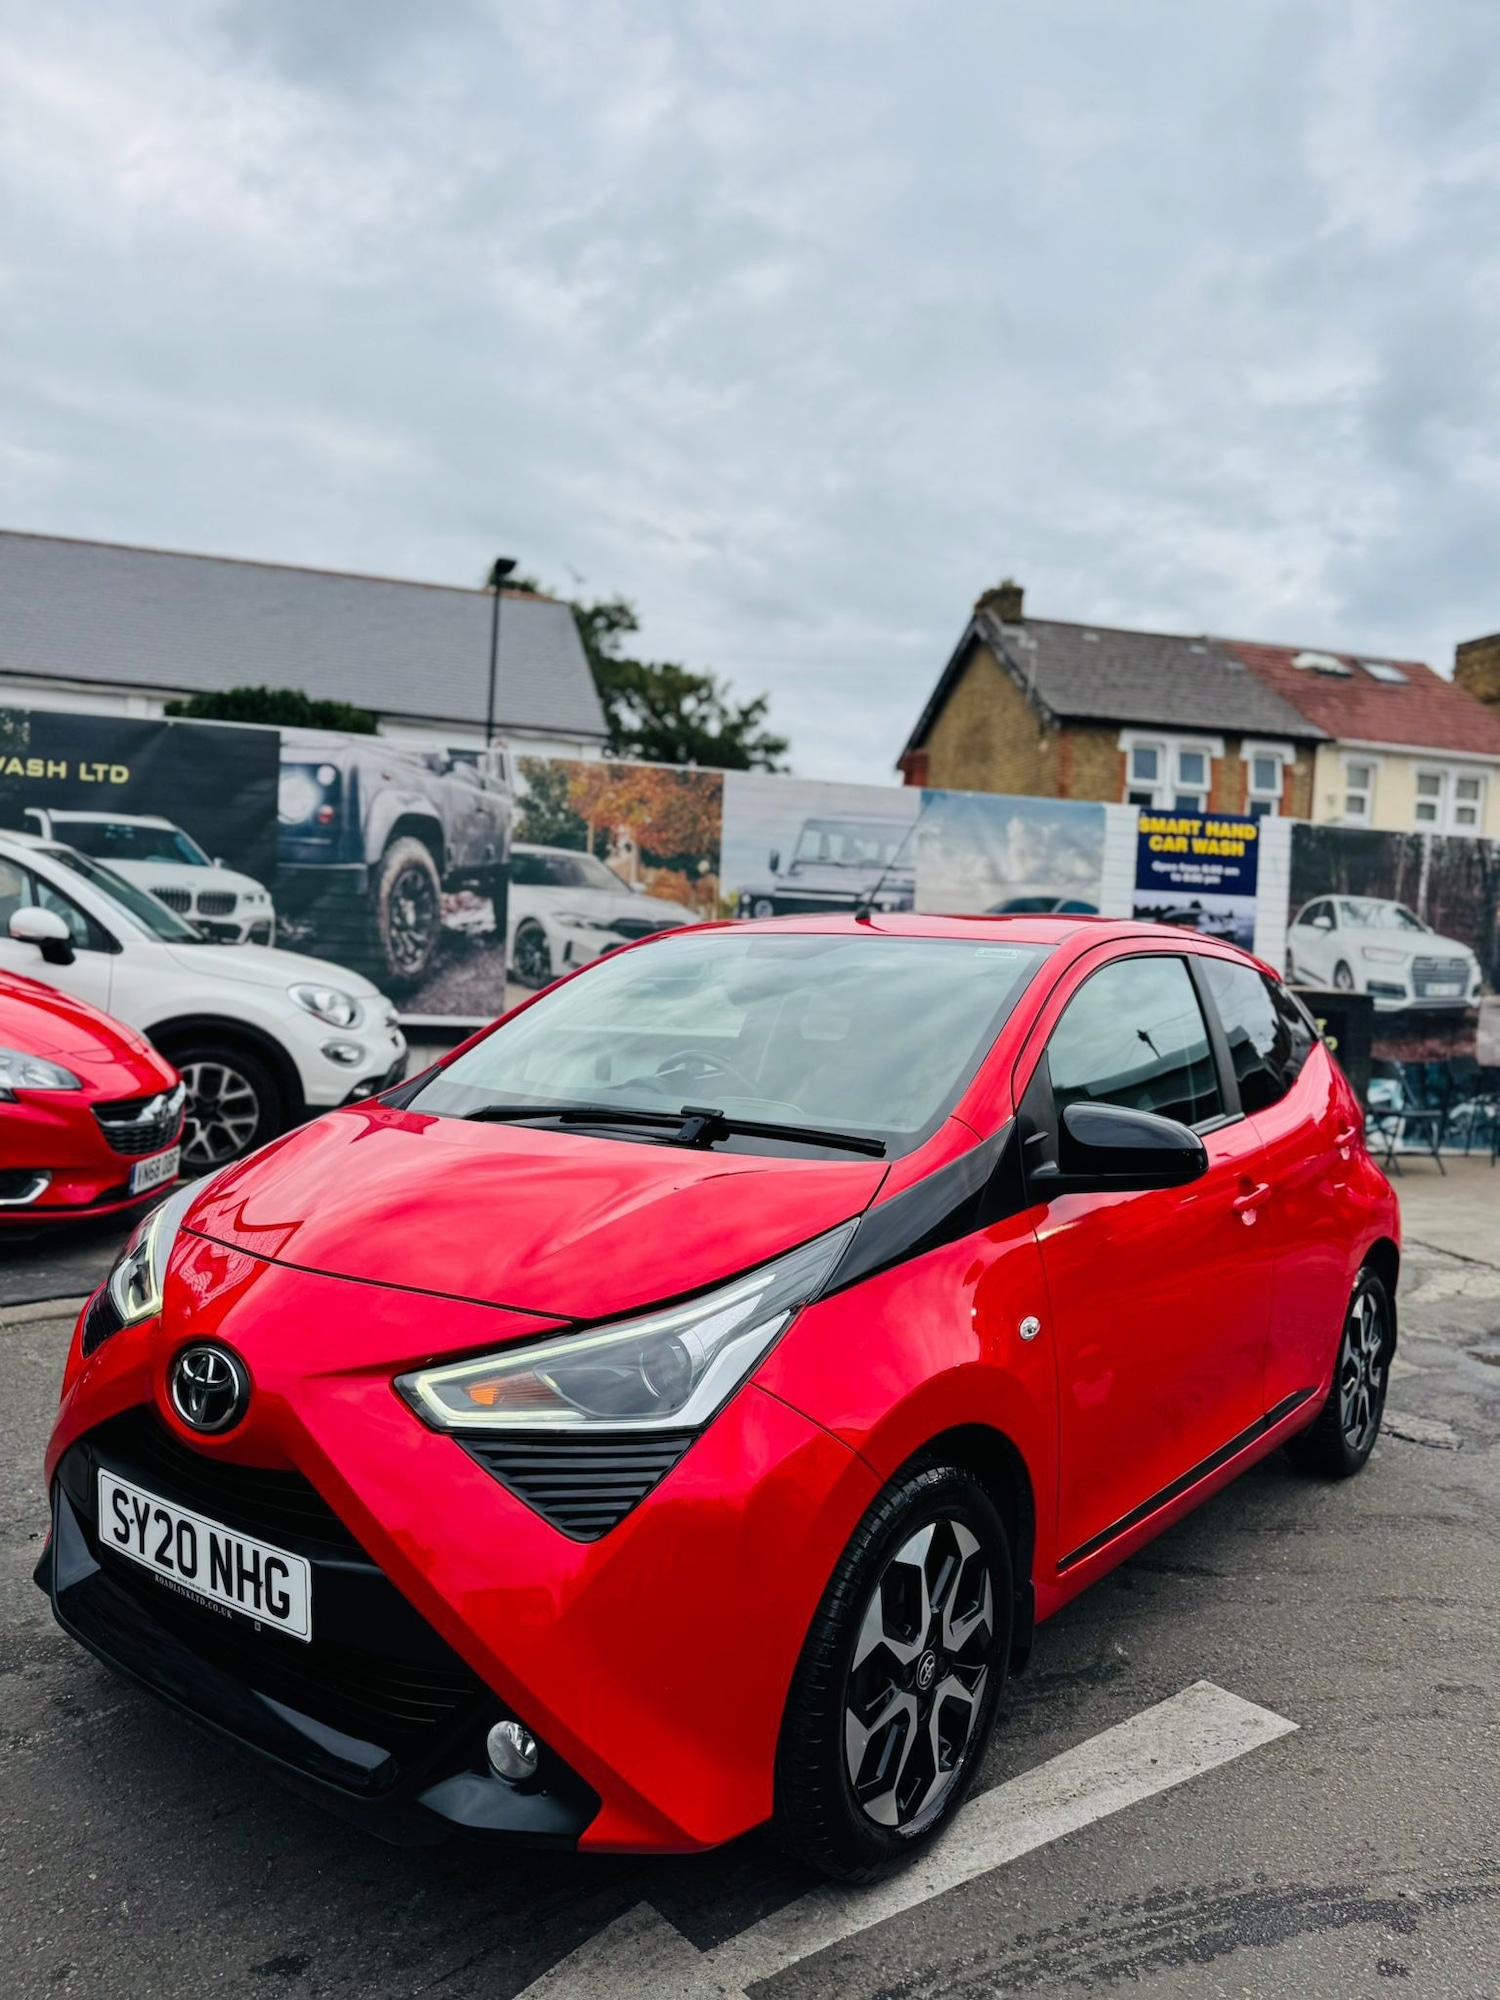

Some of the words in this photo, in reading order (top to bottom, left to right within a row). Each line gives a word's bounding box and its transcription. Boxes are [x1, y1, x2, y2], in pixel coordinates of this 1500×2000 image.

[79, 762, 130, 783] LTD
[1139, 816, 1202, 836] SMART
[1205, 821, 1257, 840] HAND
[1148, 835, 1189, 853] CAR
[1192, 838, 1245, 857] WASH
[112, 1488, 198, 1580] SY20
[209, 1532, 290, 1620] NHG
[153, 1573, 233, 1619] ROADLINKLTD.CO.UK
